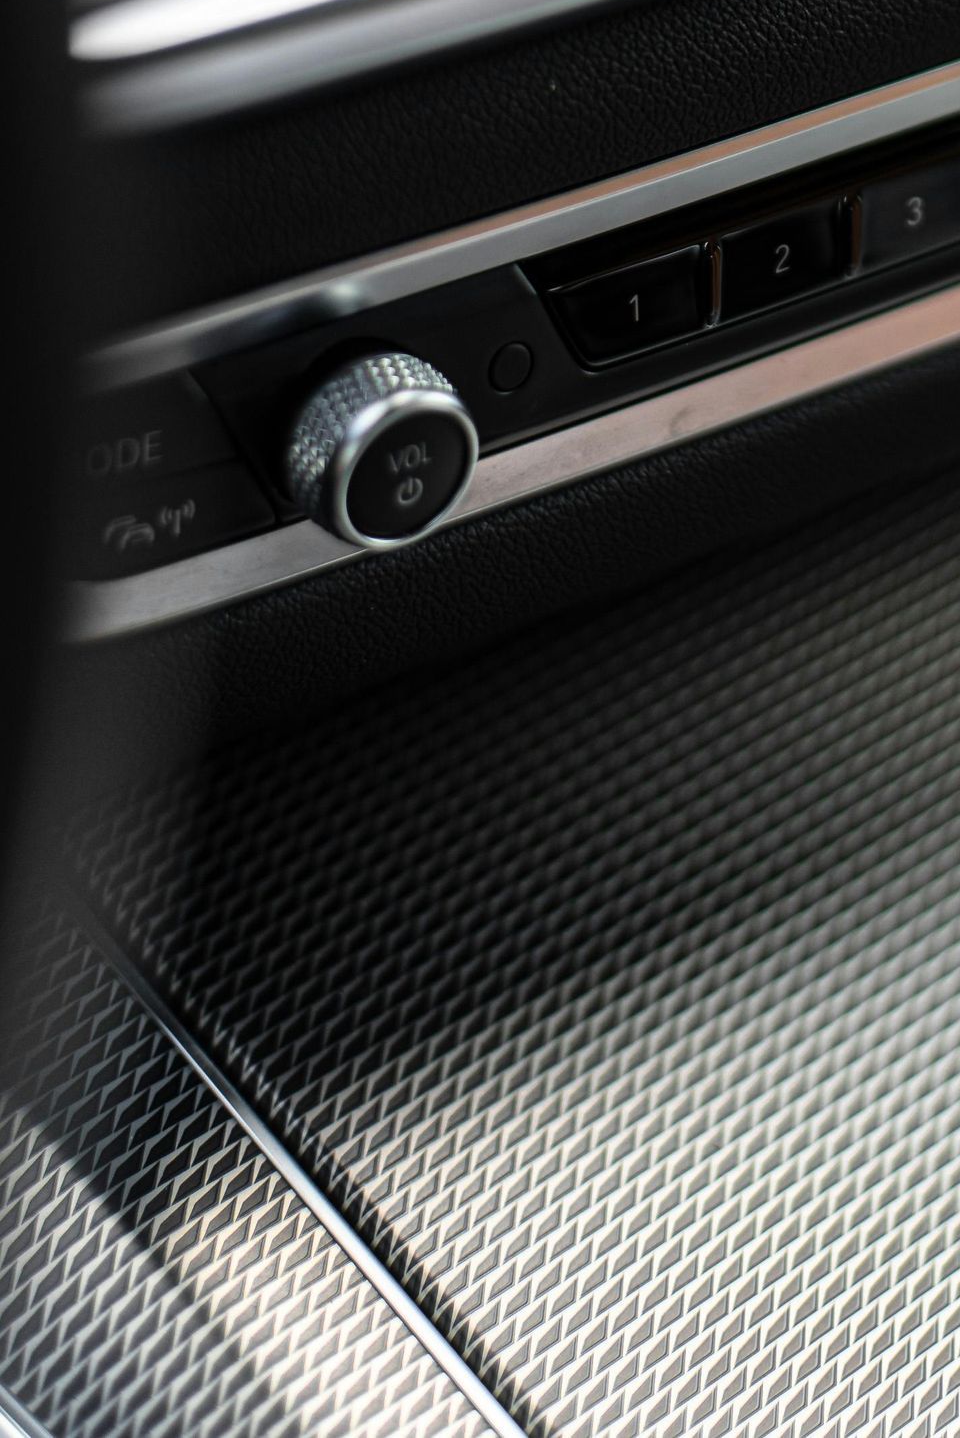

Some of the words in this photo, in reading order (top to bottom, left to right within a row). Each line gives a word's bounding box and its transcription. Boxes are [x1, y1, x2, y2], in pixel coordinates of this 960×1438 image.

[905, 195, 925, 227] 3
[774, 243, 791, 275] 2
[628, 293, 641, 323] 1
[86, 427, 163, 471] ODE
[386, 440, 433, 475] VOL
